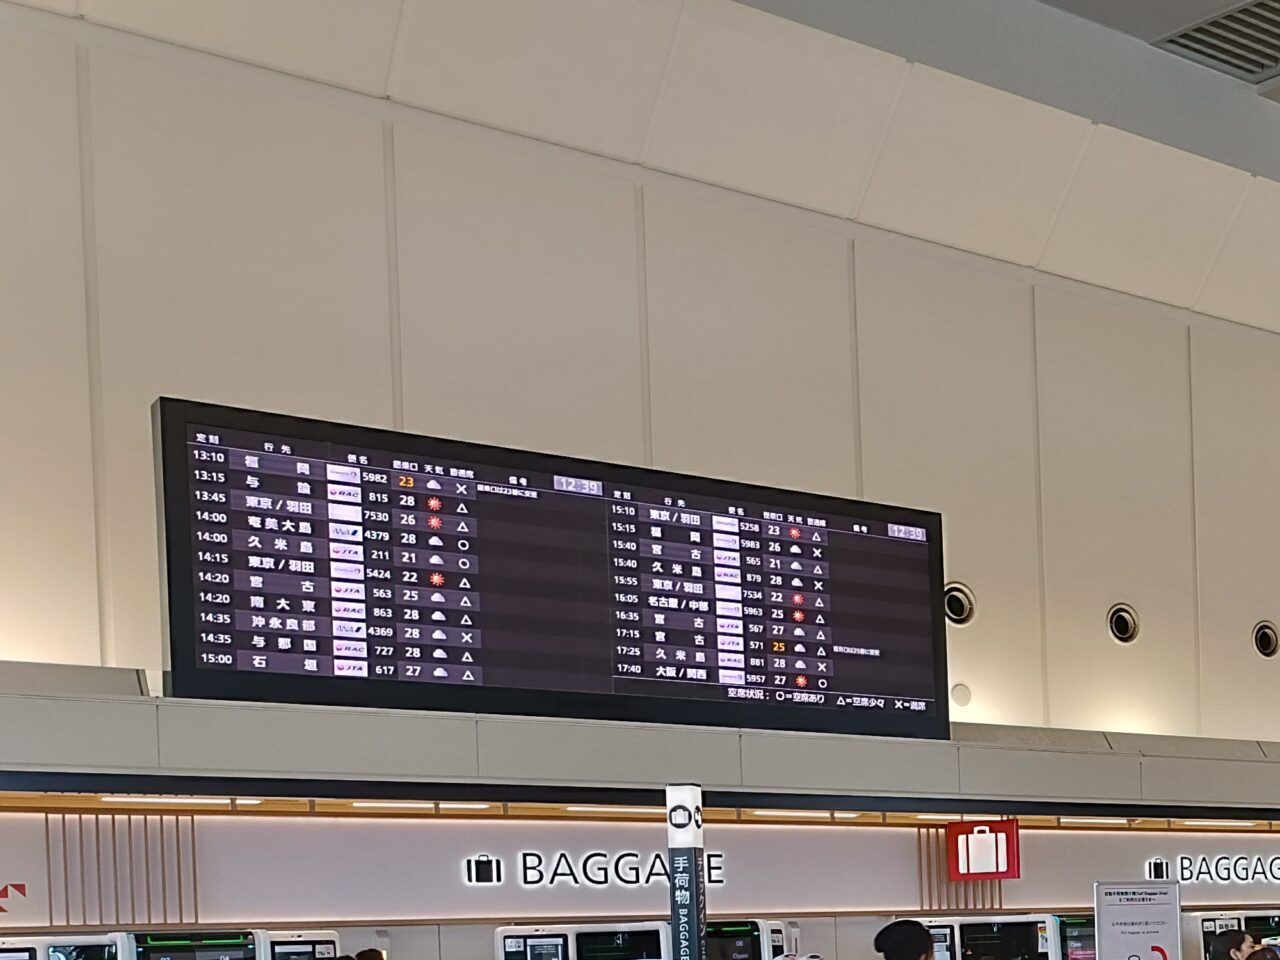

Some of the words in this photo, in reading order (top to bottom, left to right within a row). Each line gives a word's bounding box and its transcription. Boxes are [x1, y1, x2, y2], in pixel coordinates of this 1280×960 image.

[193, 450, 224, 462] 13:10
[363, 472, 387, 483] 5982
[399, 476, 414, 487] 23
[194, 470, 225, 482] 13:15
[369, 492, 388, 502] 815
[400, 495, 415, 506] 28
[561, 479, 597, 493] 12:39
[195, 491, 226, 502] 13:45
[364, 510, 389, 521] 7530
[400, 514, 415, 525] 26
[612, 505, 635, 515] 15:10
[740, 522, 759, 532] 5258
[768, 525, 780, 535] 23
[196, 511, 227, 523] 14:00
[364, 531, 389, 541] 4379
[401, 533, 416, 544] 28
[612, 523, 635, 533] 15:15
[741, 539, 760, 549] 5983
[769, 542, 781, 552] 26
[893, 526, 922, 538] 12:39
[197, 531, 227, 543] 14:00
[371, 550, 389, 560] 211
[401, 552, 416, 563] 21
[613, 541, 636, 550] 15:40
[746, 557, 760, 565] 565
[770, 559, 780, 569] 21
[198, 552, 229, 563] 14:15
[366, 569, 391, 579] 5424
[403, 571, 418, 582] 22
[613, 558, 637, 568] 15:40
[747, 574, 761, 582] 879
[770, 576, 782, 585] 28
[199, 572, 230, 583] 14:20
[373, 589, 391, 598] 563
[403, 590, 418, 601] 25
[614, 576, 638, 585] 15:55
[743, 590, 762, 599] 7534
[771, 592, 783, 602] 22
[199, 592, 230, 603] 14:20
[373, 608, 392, 617] 863
[404, 609, 419, 620] 28
[615, 593, 638, 603] 16:05
[744, 607, 763, 616] 5963
[772, 609, 783, 619] 25
[200, 613, 230, 623] 14:35
[368, 627, 393, 636] 4369
[405, 628, 420, 638] 28
[615, 611, 639, 620] 16:35
[749, 624, 763, 632] 567
[772, 626, 784, 635] 27
[201, 633, 231, 644] 14:35
[375, 646, 393, 655] 727
[405, 647, 420, 657] 28
[616, 629, 639, 638] 17:15
[750, 641, 763, 650] 571
[773, 642, 785, 651] 25
[201, 653, 232, 664] 15:00
[375, 665, 394, 675] 617
[406, 666, 421, 676] 27
[616, 646, 640, 656] 17:25
[750, 658, 764, 666] 881
[774, 659, 785, 668] 28
[617, 664, 641, 673] 17:40
[747, 675, 765, 683] 5957
[775, 676, 786, 685] 27
[522, 852, 724, 884] BAGGAE
[674, 856, 689, 905] 手荷物
